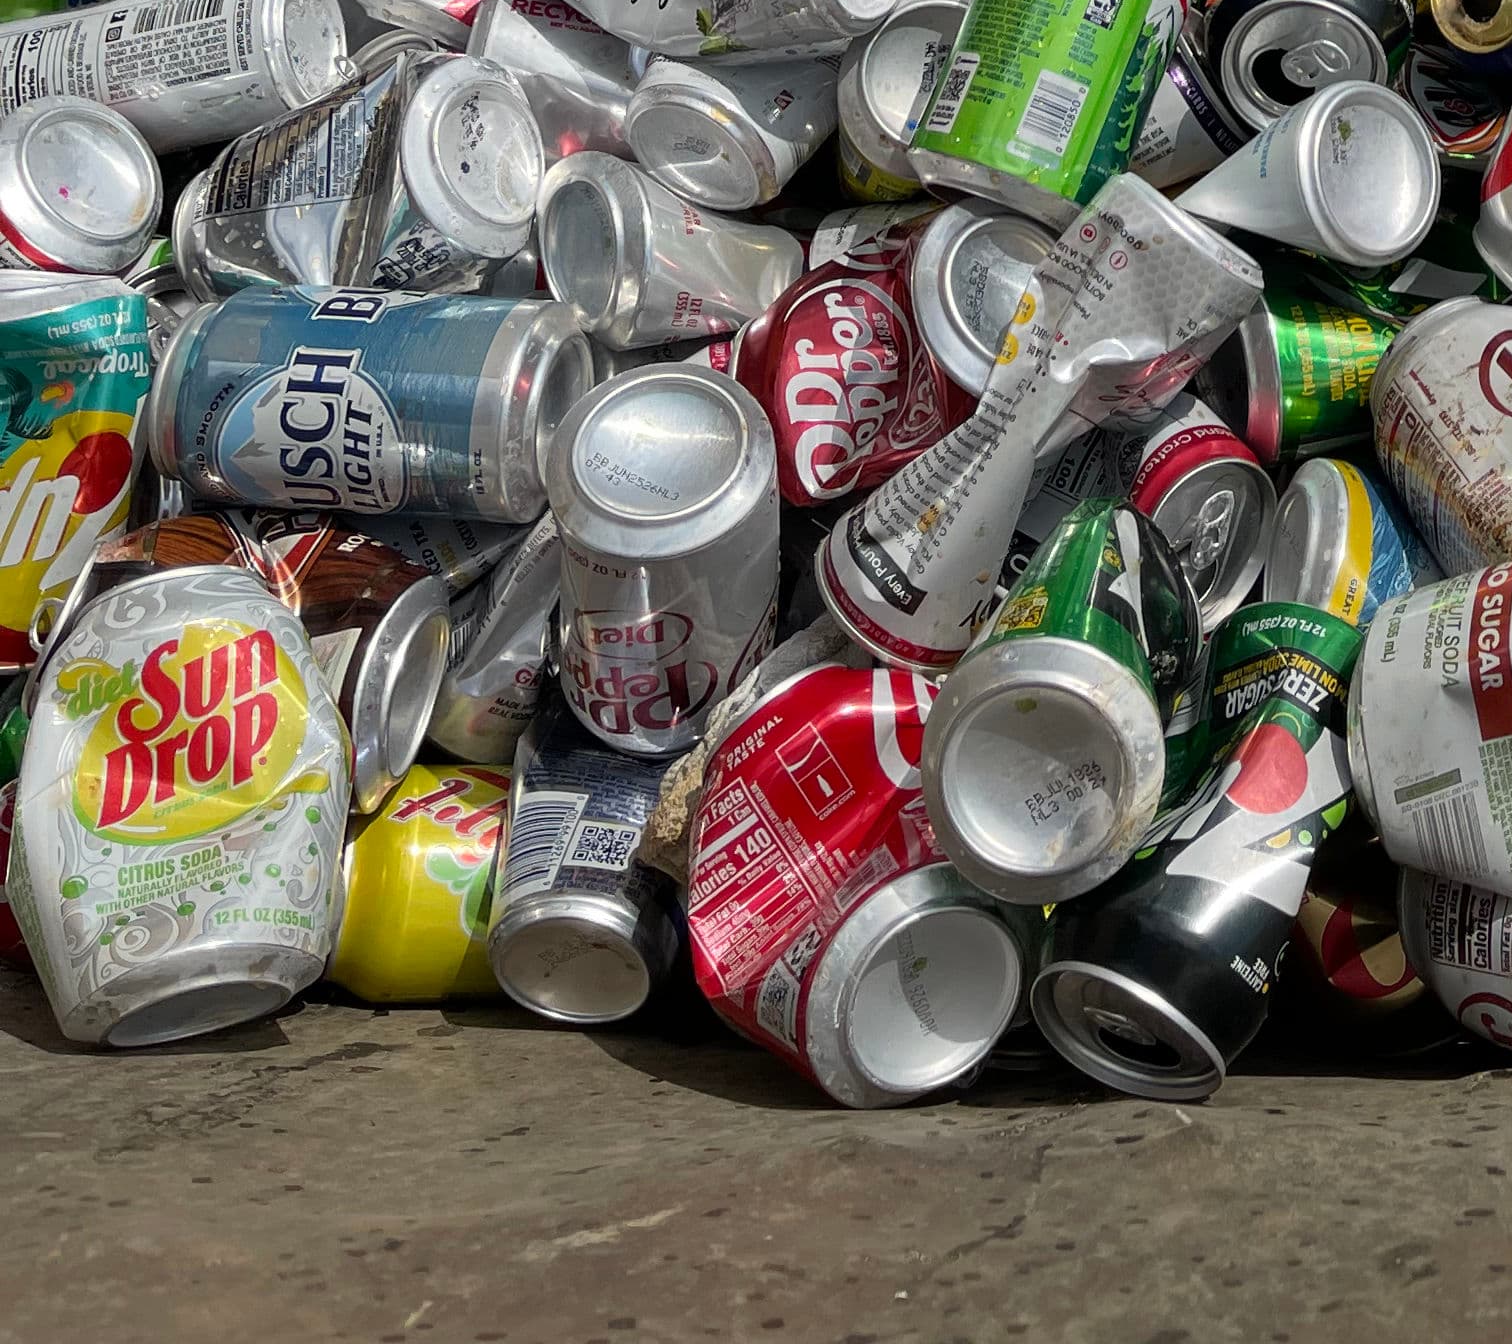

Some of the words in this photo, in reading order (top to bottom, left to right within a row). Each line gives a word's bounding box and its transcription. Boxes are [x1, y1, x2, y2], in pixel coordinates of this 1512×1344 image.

[232, 155, 253, 209] Calories
[41, 348, 151, 380] Tropical
[193, 381, 236, 452] SMOOTH
[338, 400, 378, 509] LIGHT
[1439, 634, 1462, 691] SODA
[1481, 593, 1504, 692] SUGAR
[68, 663, 138, 720] diet
[116, 629, 280, 744] Sun
[1223, 677, 1281, 721] SUGAR
[97, 690, 280, 829] Drop
[725, 714, 785, 764] ORIGINAL
[726, 739, 767, 772] TASTE
[710, 788, 746, 819] Facts
[817, 789, 857, 822] coke.com
[117, 860, 175, 887] CITRUS
[180, 845, 222, 871] SODA
[733, 830, 773, 863] 140
[95, 901, 122, 915] WITH
[123, 893, 155, 909] OTHER
[156, 879, 200, 899] NATURAL
[201, 862, 245, 883] FLAVORS
[117, 878, 173, 898] NATURALLY
[174, 860, 223, 886] FLAVORED
[213, 910, 231, 925] 12
[232, 910, 249, 923] FL
[253, 908, 271, 922] OZ
[272, 910, 299, 927] (355
[1431, 884, 1448, 961] Nutrition
[1473, 898, 1491, 969] Calories
